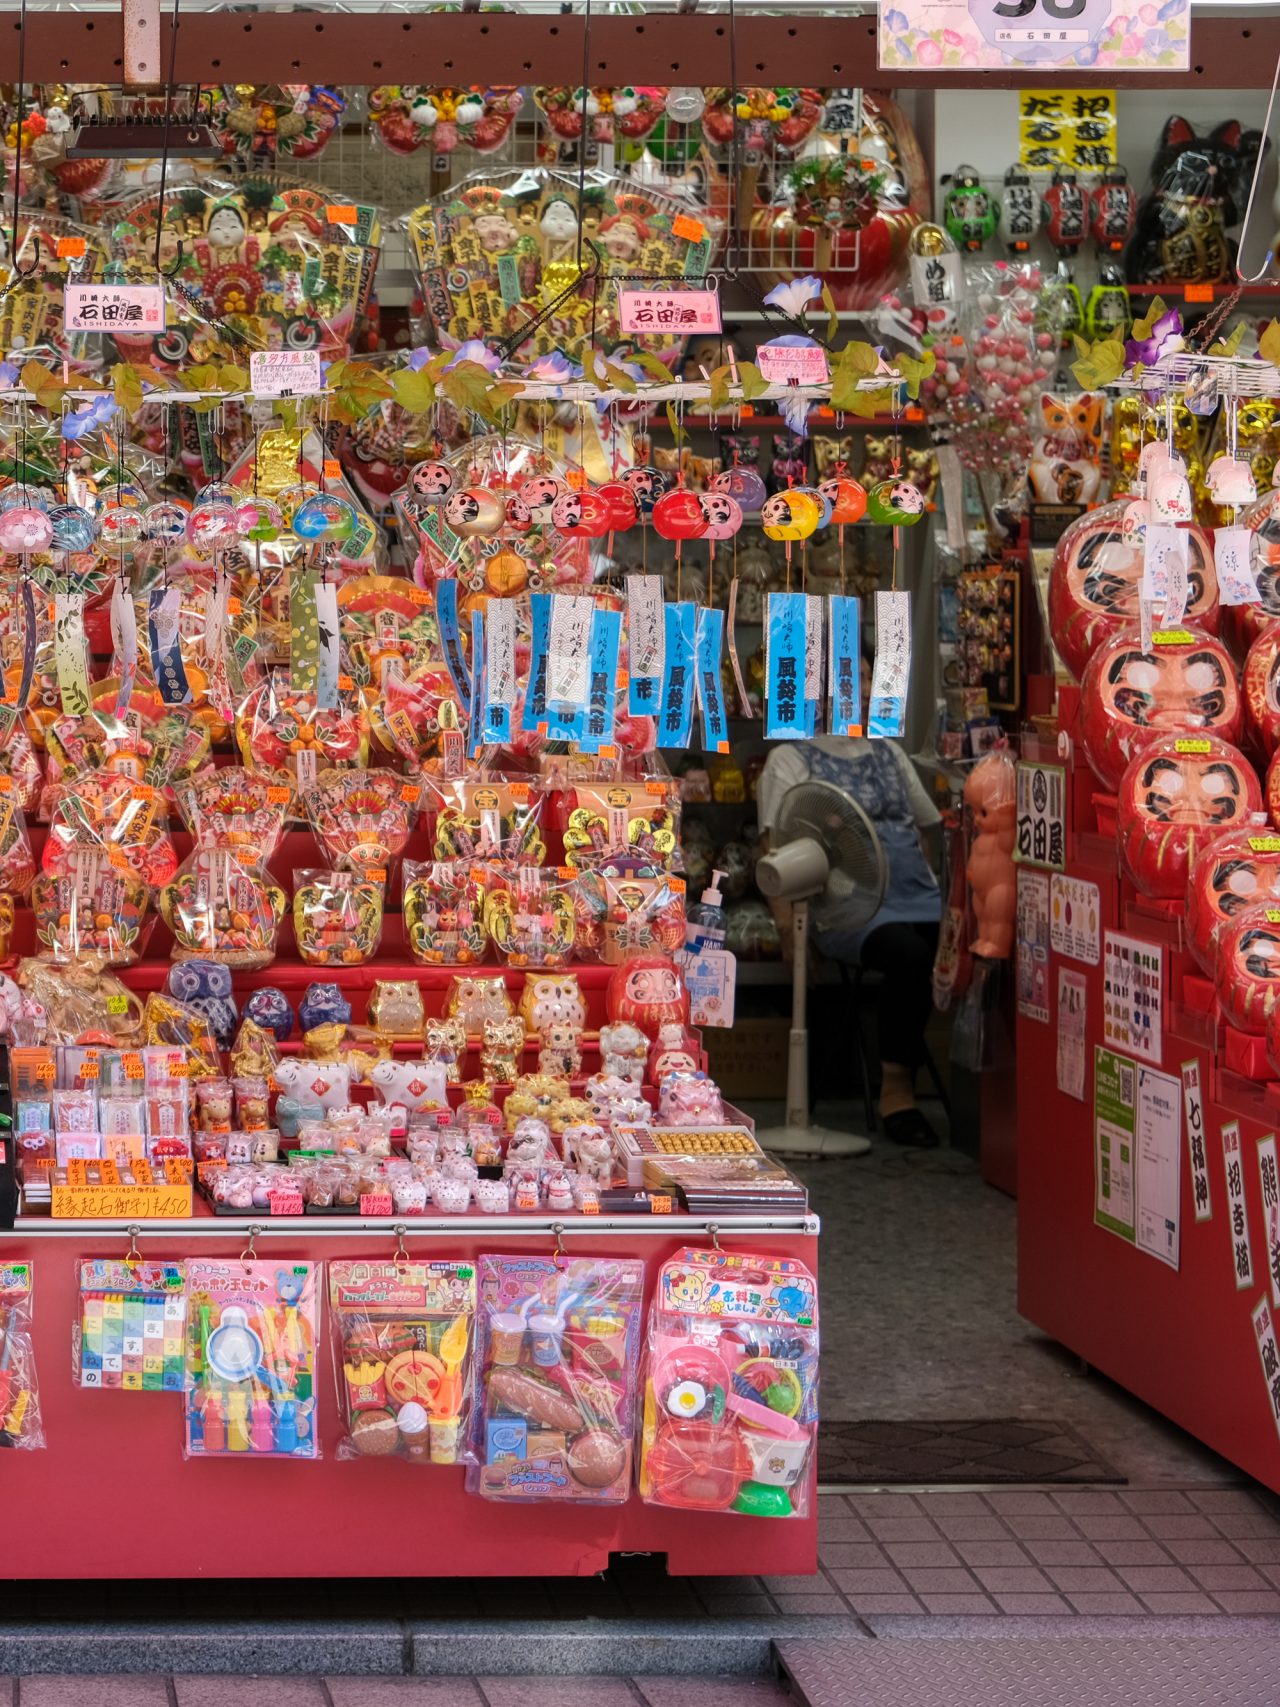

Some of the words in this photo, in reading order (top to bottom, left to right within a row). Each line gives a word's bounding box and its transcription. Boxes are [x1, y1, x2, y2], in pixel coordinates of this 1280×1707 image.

[1027, 32, 1067, 40] 石田屋
[79, 302, 144, 321] 石田屋
[634, 308, 699, 324] 石田屋
[666, 665, 686, 732] 風鈴市
[703, 671, 721, 736] 風鈴市
[777, 656, 797, 723] 風鈴市
[839, 657, 854, 721] 風鈴市
[127, 800, 152, 842] 家内安全
[1017, 814, 1063, 865] 石田屋
[1188, 1096, 1209, 1211] 七福神
[152, 1197, 188, 1216] ¥450
[1227, 1160, 1251, 1279] 招き猫
[192, 1277, 269, 1292] シャボン玉セット
[722, 1290, 761, 1307] お料理
[775, 1359, 797, 1368] 日本製
